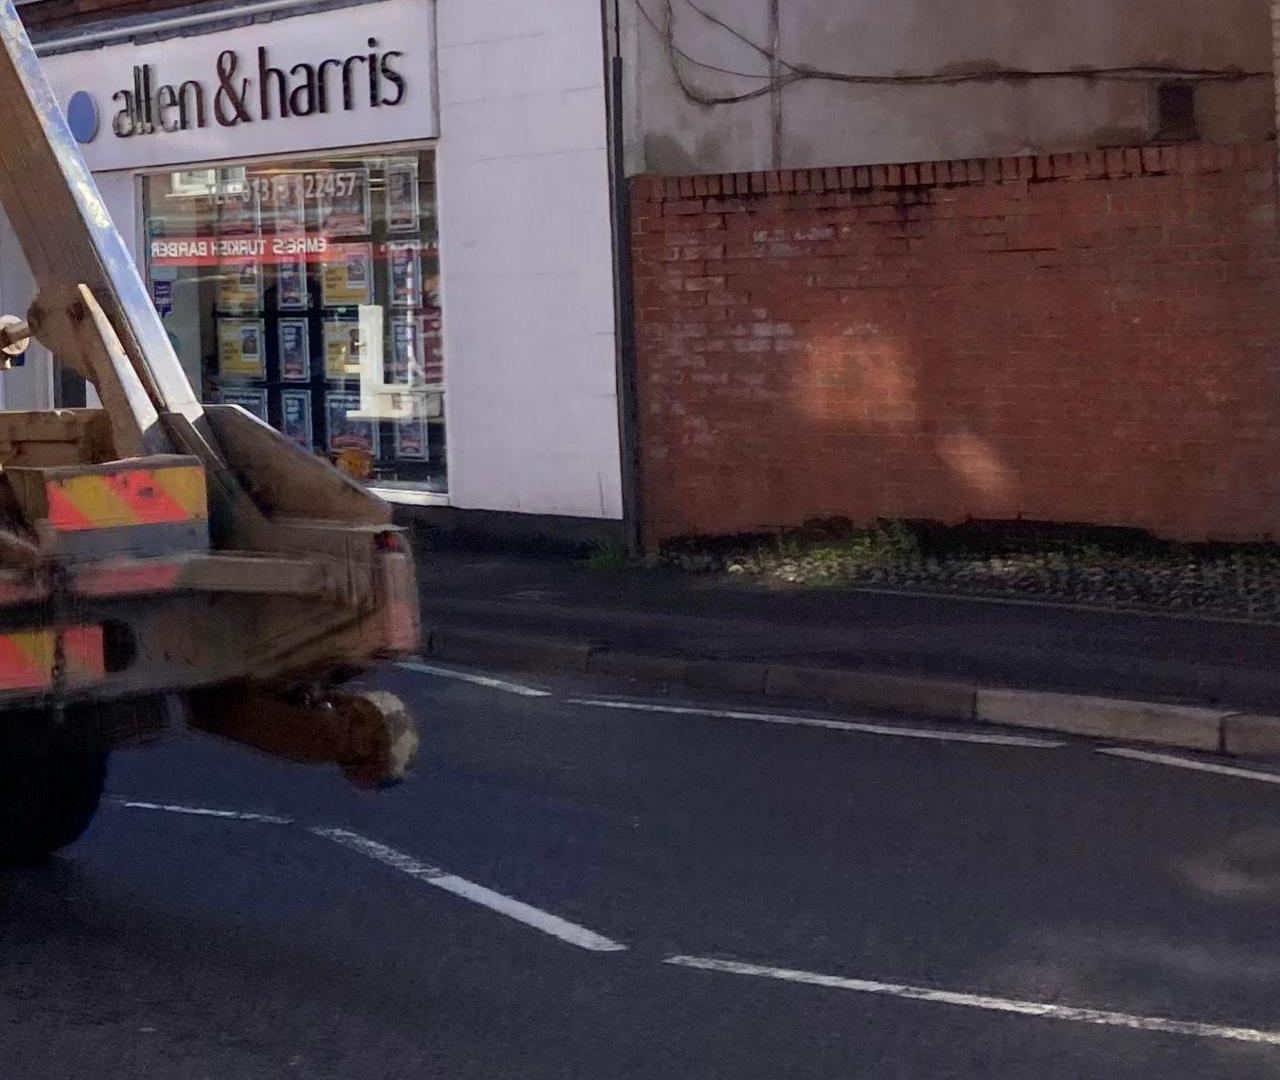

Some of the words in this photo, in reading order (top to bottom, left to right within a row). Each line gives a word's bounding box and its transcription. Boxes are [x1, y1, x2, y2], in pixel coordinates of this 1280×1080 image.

[112, 64, 204, 138] allen
[214, 50, 252, 127] &
[258, 37, 405, 121] harris
